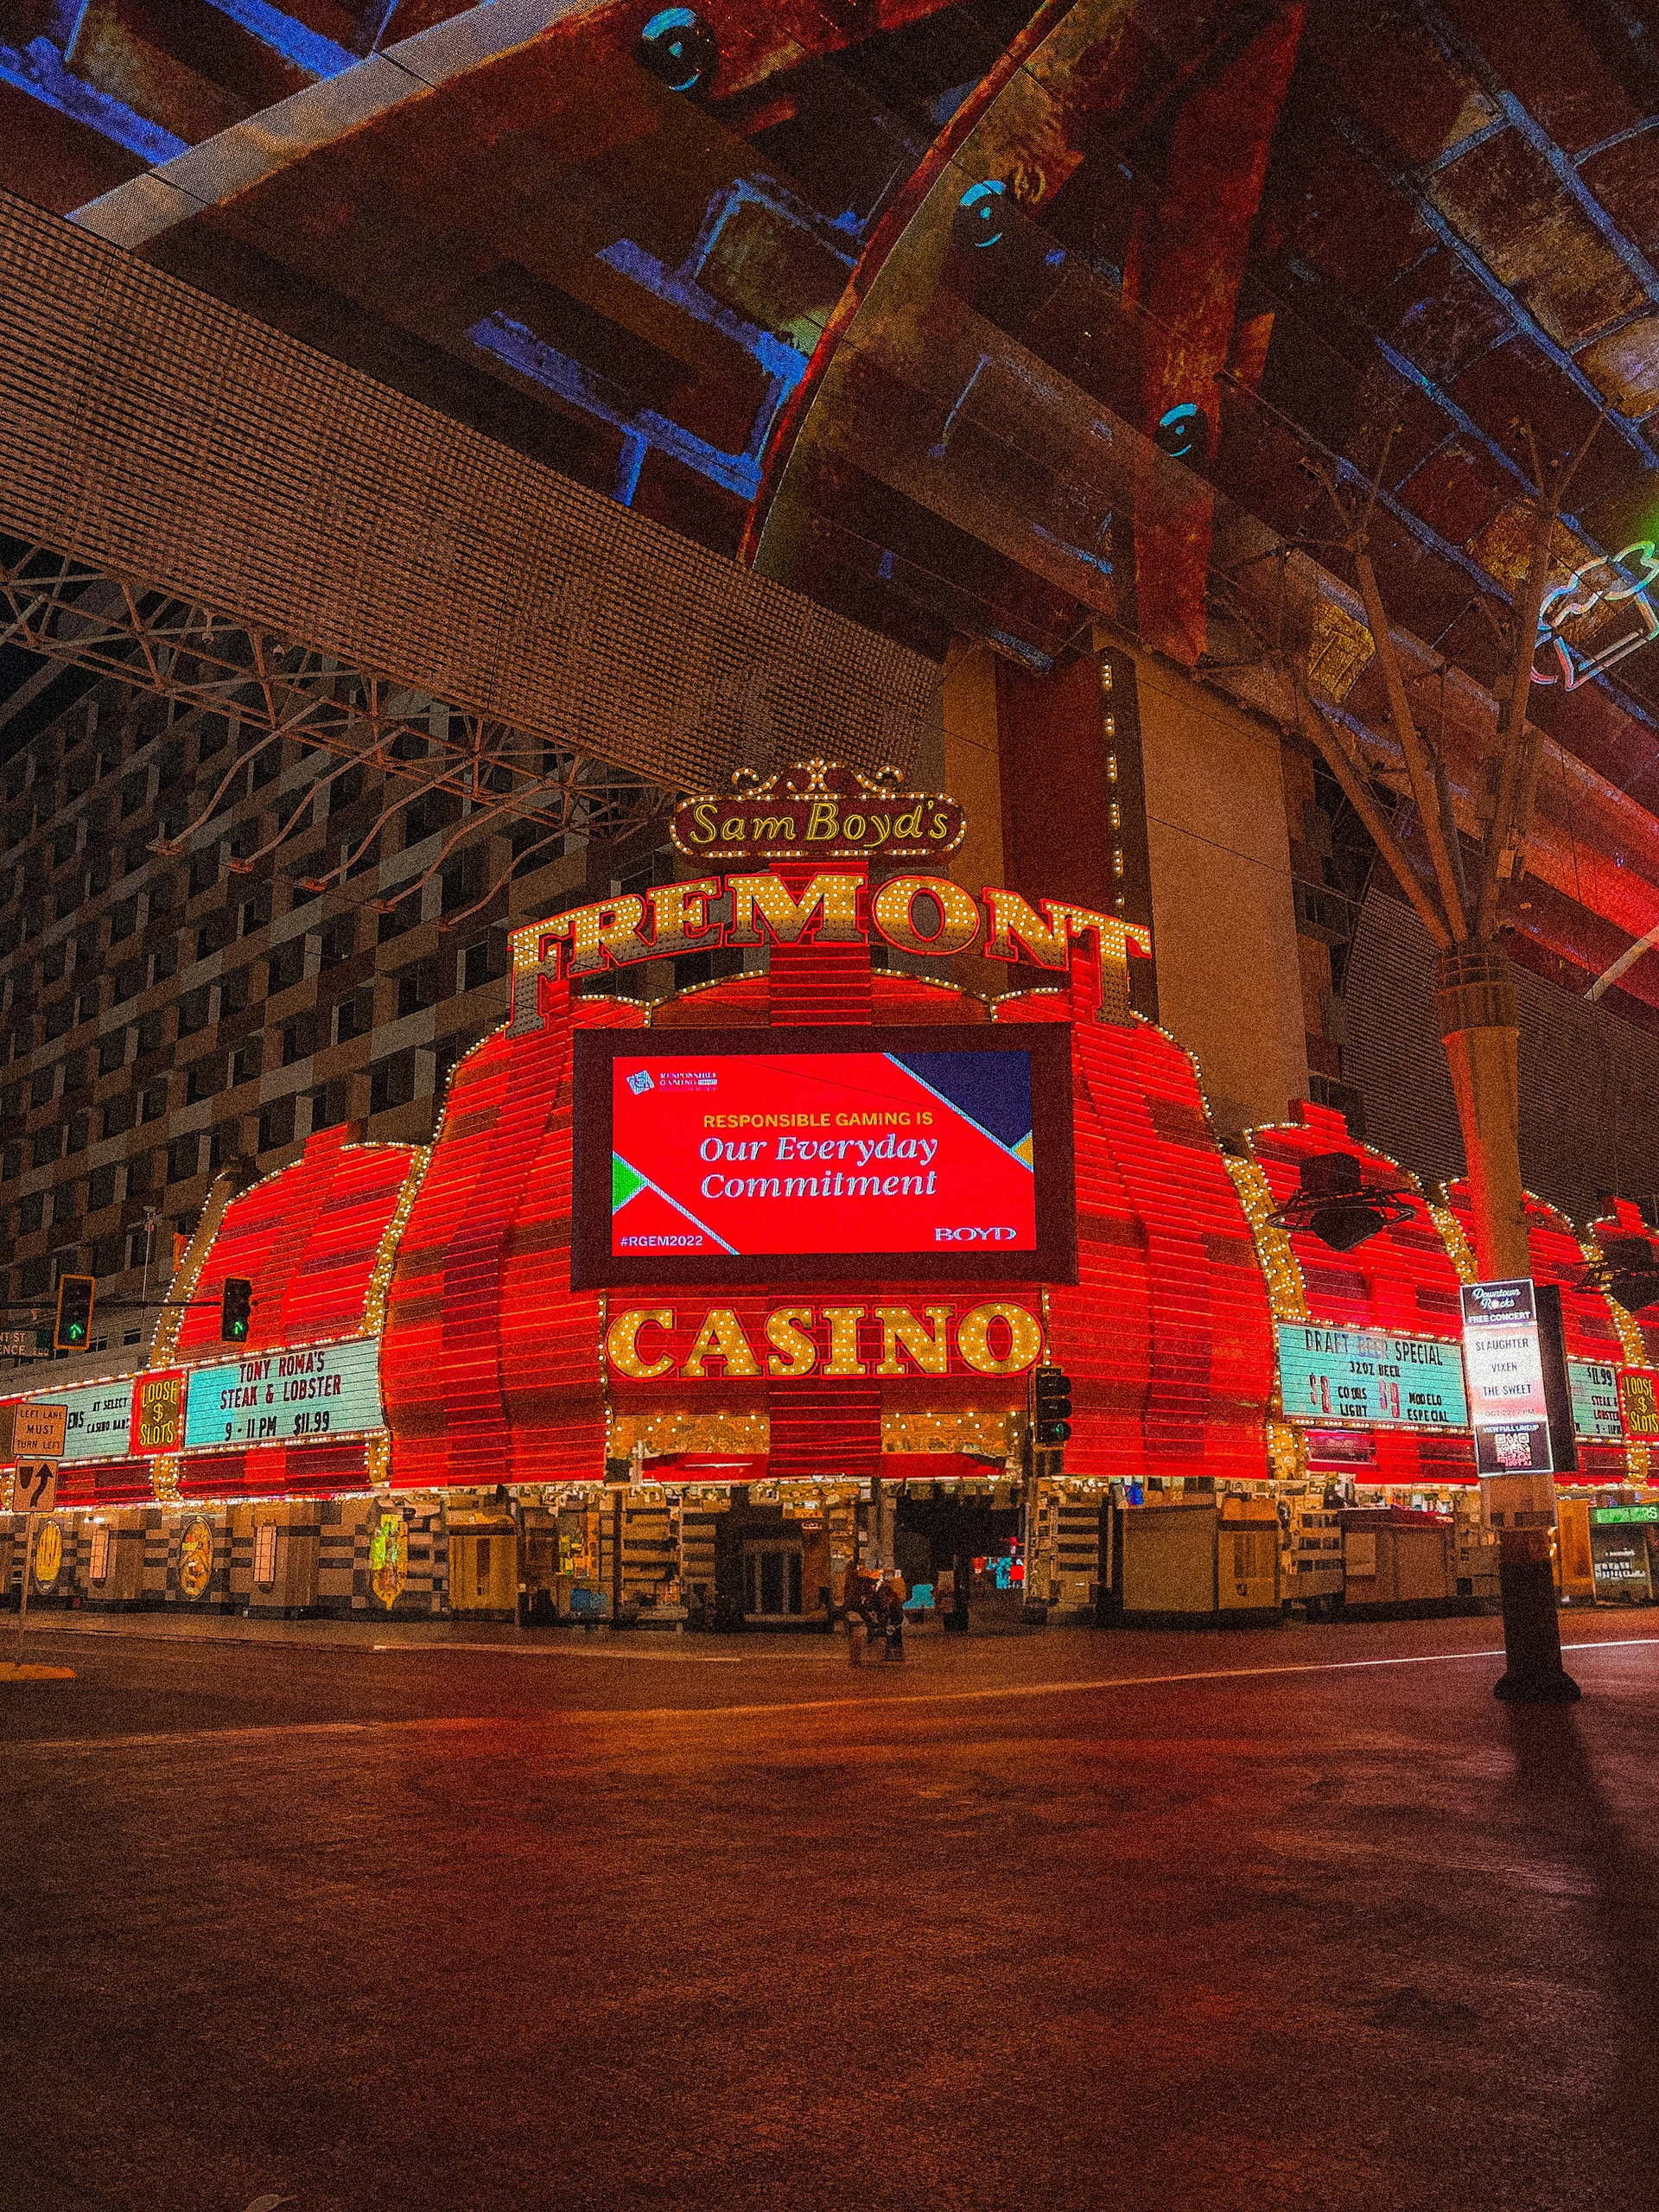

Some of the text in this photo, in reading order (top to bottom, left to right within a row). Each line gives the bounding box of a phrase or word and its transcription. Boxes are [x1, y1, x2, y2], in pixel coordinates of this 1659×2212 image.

[690, 799, 949, 848] Sam Boyd's
[506, 871, 1153, 1039] FREMONT
[703, 1112, 933, 1128] RESPONSIBLE GAMING IS
[700, 1133, 938, 1166] Our Everyday
[701, 1170, 938, 1198] Commitment
[935, 1227, 1017, 1241] BOYD
[620, 1235, 703, 1248] #RGEM2022
[1472, 1288, 1521, 1300] Downtown
[1480, 1298, 1516, 1310] Rocks
[1490, 1312, 1530, 1322] CONCERT
[13, 1332, 26, 1342] ST
[607, 1302, 1044, 1379] CASINO
[1305, 1329, 1443, 1366] DRAFT BEER SPECIAL
[1476, 1338, 1529, 1351] SLAUGHTER
[239, 1351, 325, 1383] TONY ROMA'S
[1378, 1363, 1401, 1377] BEER
[1491, 1362, 1517, 1372] VIXEN
[141, 1380, 178, 1408] LOOSE
[220, 1375, 341, 1409] STEAK & LOBSTER
[1483, 1384, 1531, 1396] THE SWEET
[1625, 1376, 1656, 1400] LOOSE
[103, 1397, 128, 1410] SELECT
[1409, 1392, 1442, 1407] MODELO
[43, 1411, 63, 1420] LANE
[1339, 1404, 1368, 1417] LIGHT
[1408, 1408, 1449, 1422] ESPECIAL
[87, 1421, 110, 1433] CASINO
[225, 1422, 232, 1441] 9
[293, 1411, 330, 1436] $11.99
[1630, 1411, 1659, 1433] SLOTS
[26, 1425, 54, 1434] MUST
[140, 1421, 174, 1446] SLOTS
[17, 1440, 61, 1450] TURN LEFT
